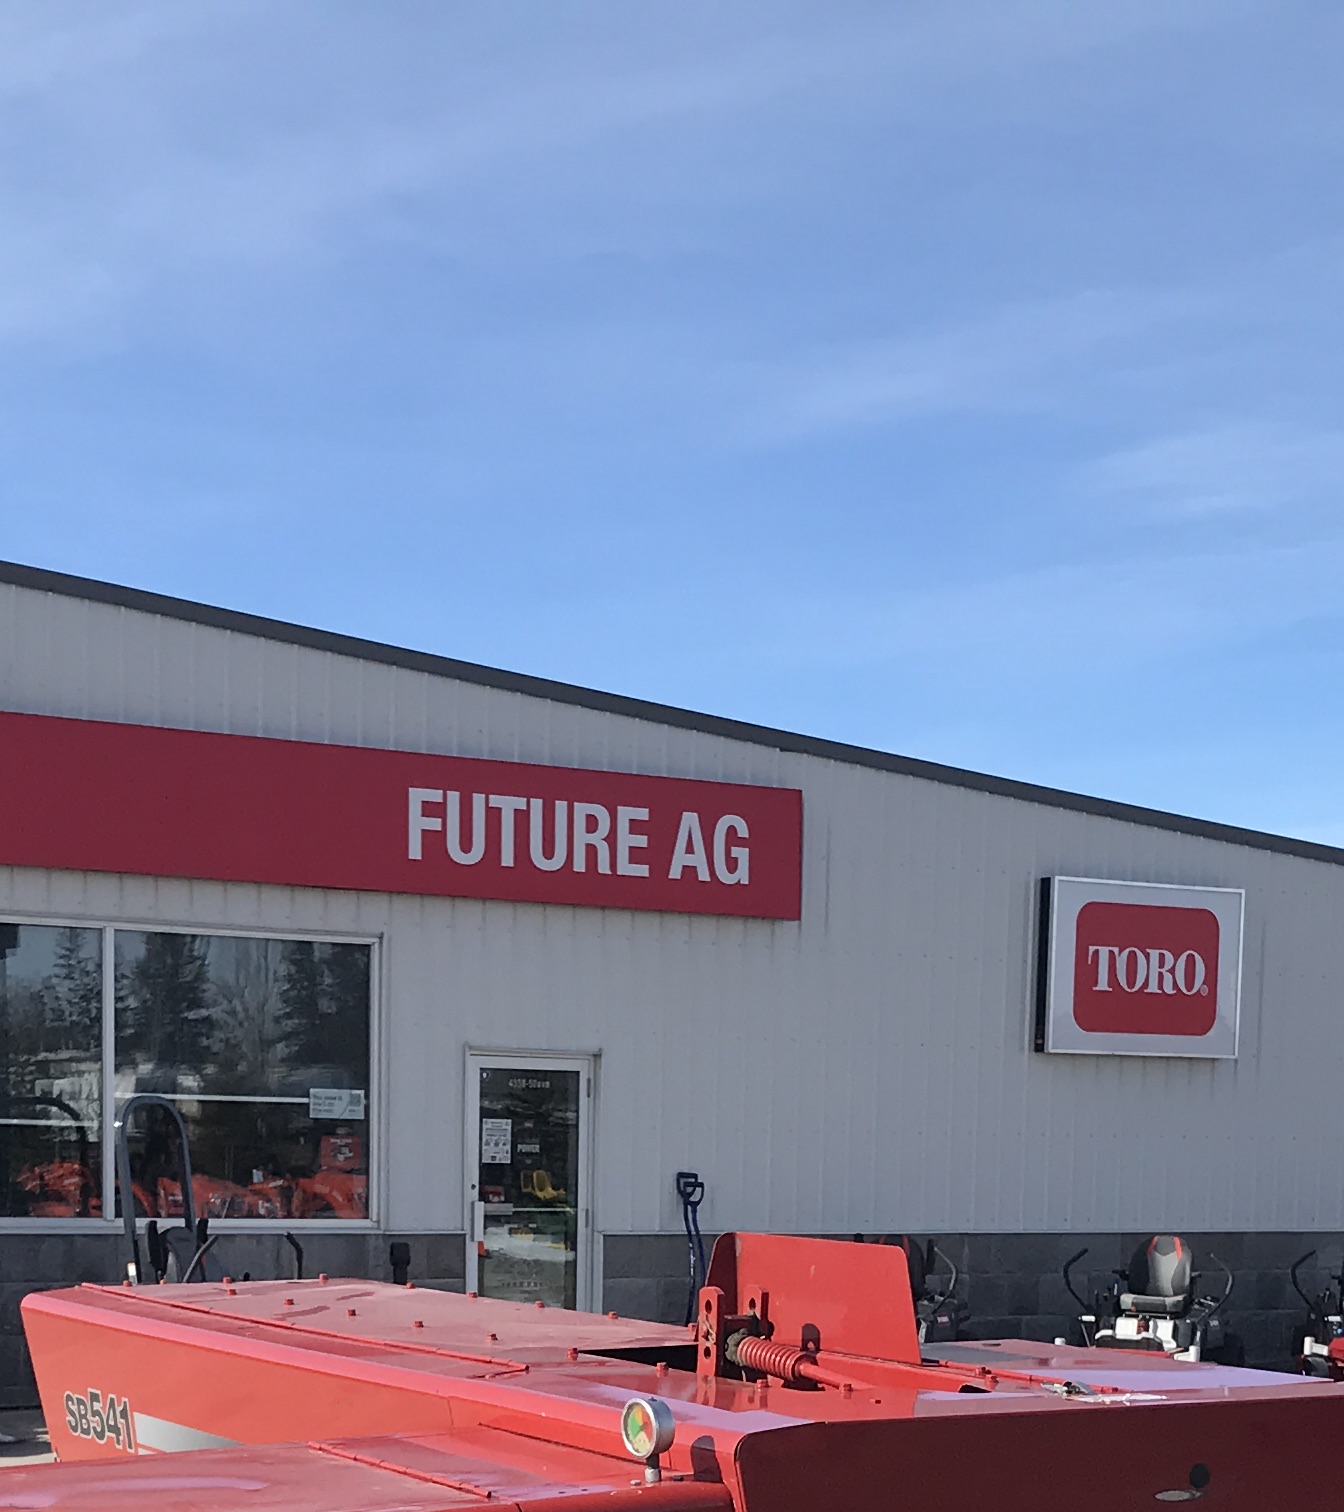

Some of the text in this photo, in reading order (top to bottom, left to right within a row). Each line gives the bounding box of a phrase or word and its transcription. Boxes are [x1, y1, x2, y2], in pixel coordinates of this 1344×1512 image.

[407, 787, 751, 886] FUTURE AG
[1087, 945, 1207, 997] TORO
[63, 1387, 134, 1453] SB541
